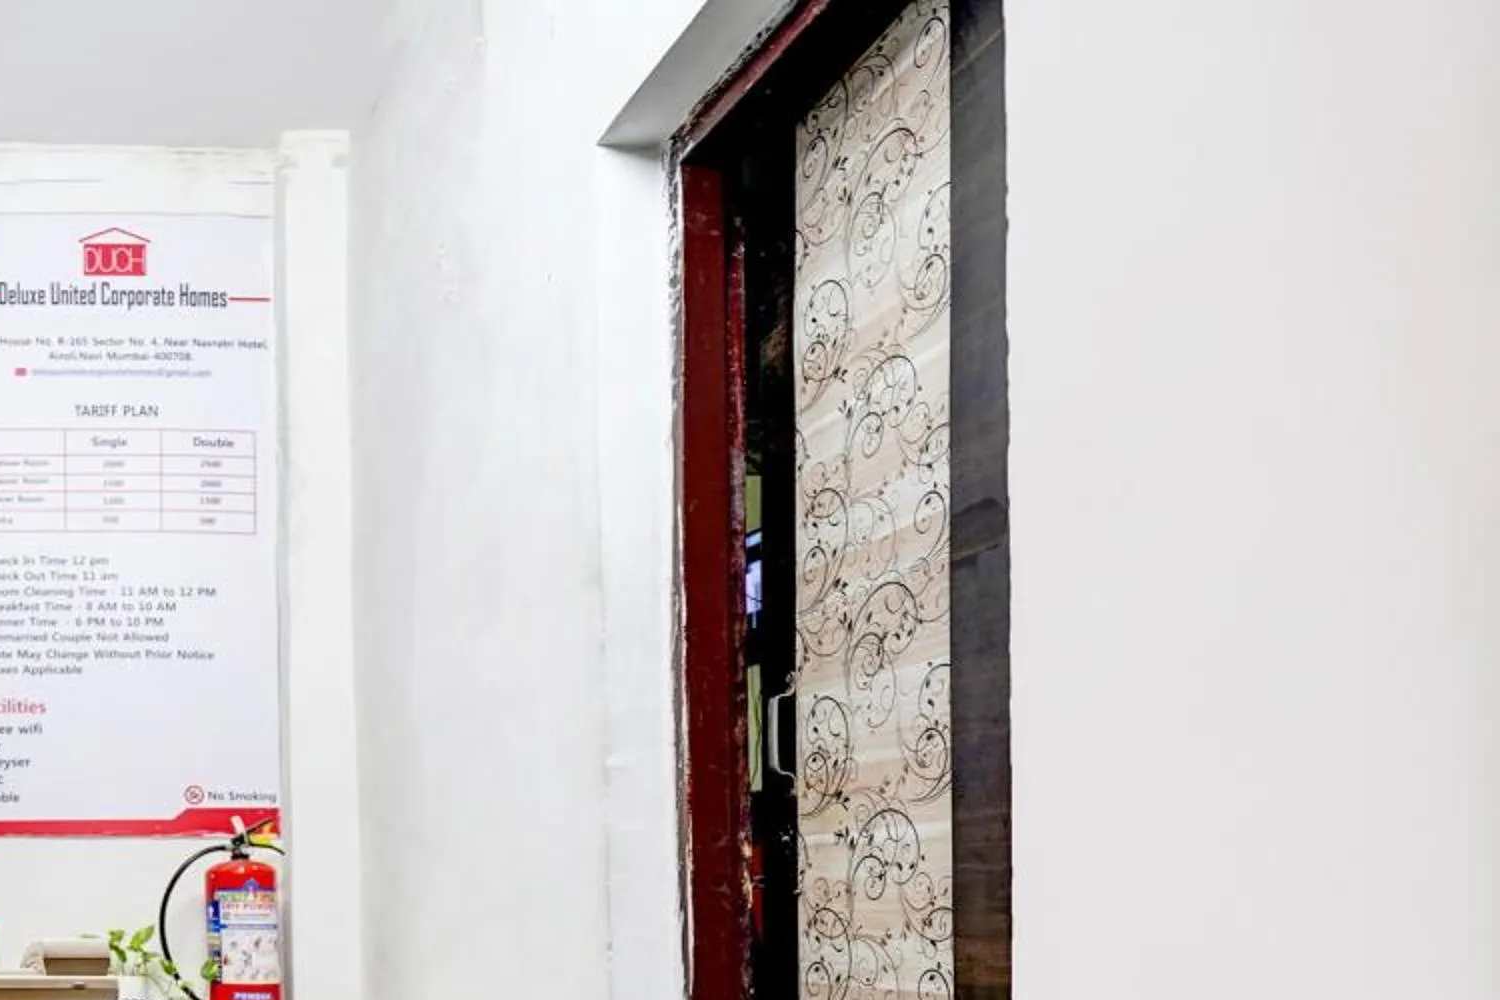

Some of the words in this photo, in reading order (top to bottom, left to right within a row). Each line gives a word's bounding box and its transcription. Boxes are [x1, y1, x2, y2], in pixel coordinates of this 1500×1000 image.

[50, 282, 97, 305] United
[101, 282, 175, 310] Corporate
[180, 283, 228, 308] Homes
[92, 336, 125, 346] Sector
[163, 336, 188, 346] Near
[74, 405, 118, 418] TARIFF
[123, 405, 159, 418] PLAN
[91, 436, 127, 449] Single
[192, 437, 234, 449] Double
[22, 555, 35, 566] In
[39, 555, 69, 566] Time
[73, 555, 86, 566] 12
[89, 557, 110, 567] pm
[23, 571, 45, 581] Out
[50, 571, 78, 581] Time
[83, 571, 96, 581] 11
[100, 573, 118, 581] am
[23, 586, 74, 598] Cleaning
[78, 586, 107, 597] Time
[138, 587, 159, 597] AM
[163, 587, 175, 597] to
[179, 587, 193, 597] 12
[197, 587, 217, 597] PM
[44, 601, 73, 612] Time
[97, 601, 118, 612] AM
[122, 602, 135, 612] to
[138, 602, 153, 612] 10
[156, 602, 177, 612] AM
[29, 616, 58, 627] Time
[87, 616, 106, 627] PM
[109, 617, 123, 627] to
[126, 617, 141, 627] 10
[144, 617, 164, 627] PM
[52, 632, 92, 644] Couple
[97, 632, 119, 642] Not
[123, 632, 170, 643] Allowed
[17, 649, 41, 662] May
[45, 648, 89, 662] Change
[93, 648, 141, 660] Without
[145, 649, 173, 660] Prior
[177, 649, 215, 660] Notice
[22, 664, 83, 677] Applicable
[18, 723, 43, 735] wifi
[207, 791, 225, 802] No
[229, 791, 277, 804] Smoking
